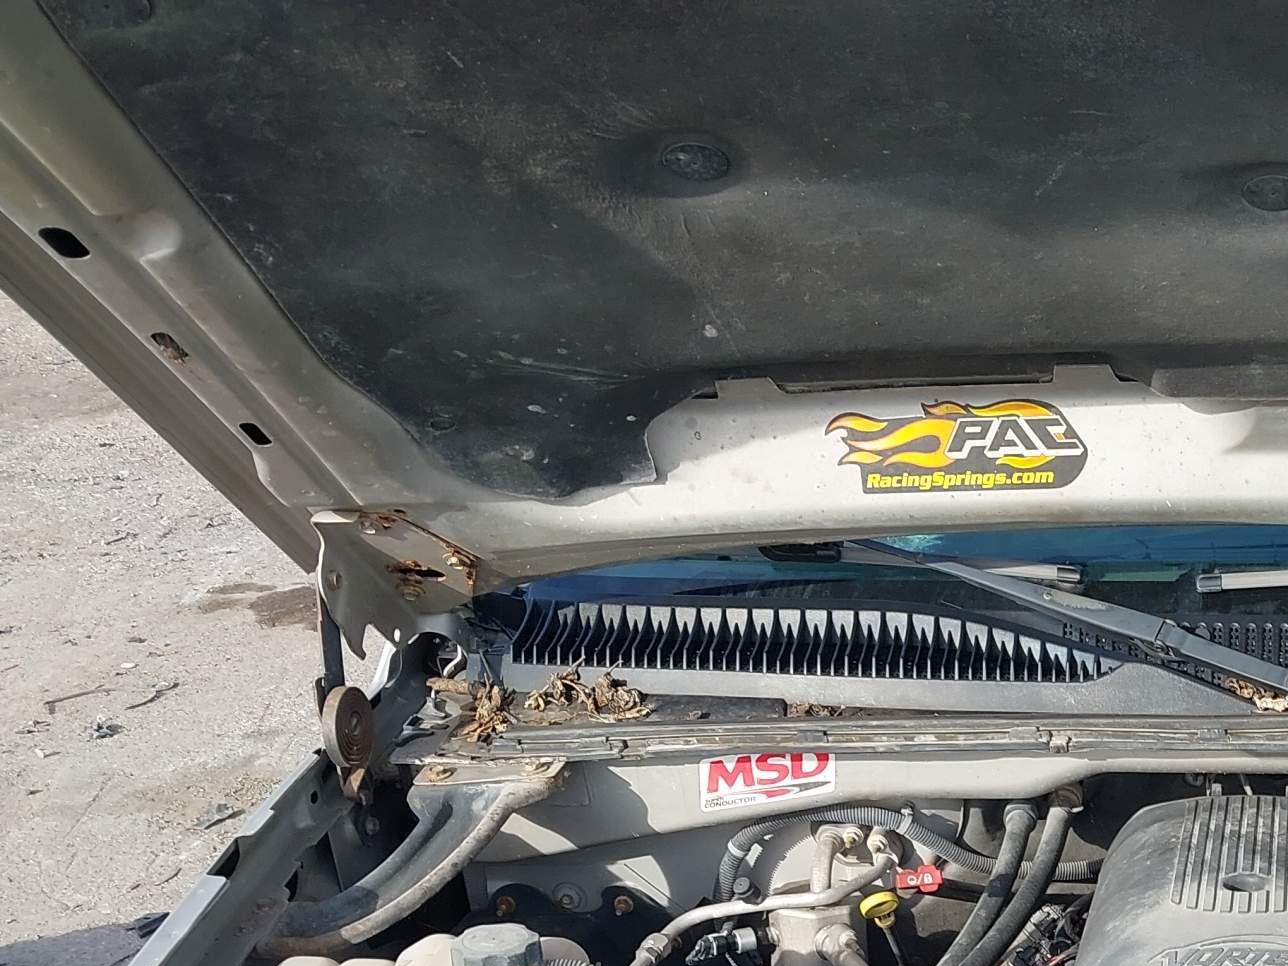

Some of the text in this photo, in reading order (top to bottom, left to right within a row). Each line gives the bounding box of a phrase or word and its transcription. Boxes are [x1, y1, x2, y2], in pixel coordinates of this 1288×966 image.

[945, 415, 1085, 459] PAC
[866, 470, 1055, 490] RacingSprings.com
[707, 752, 830, 793] MSD
